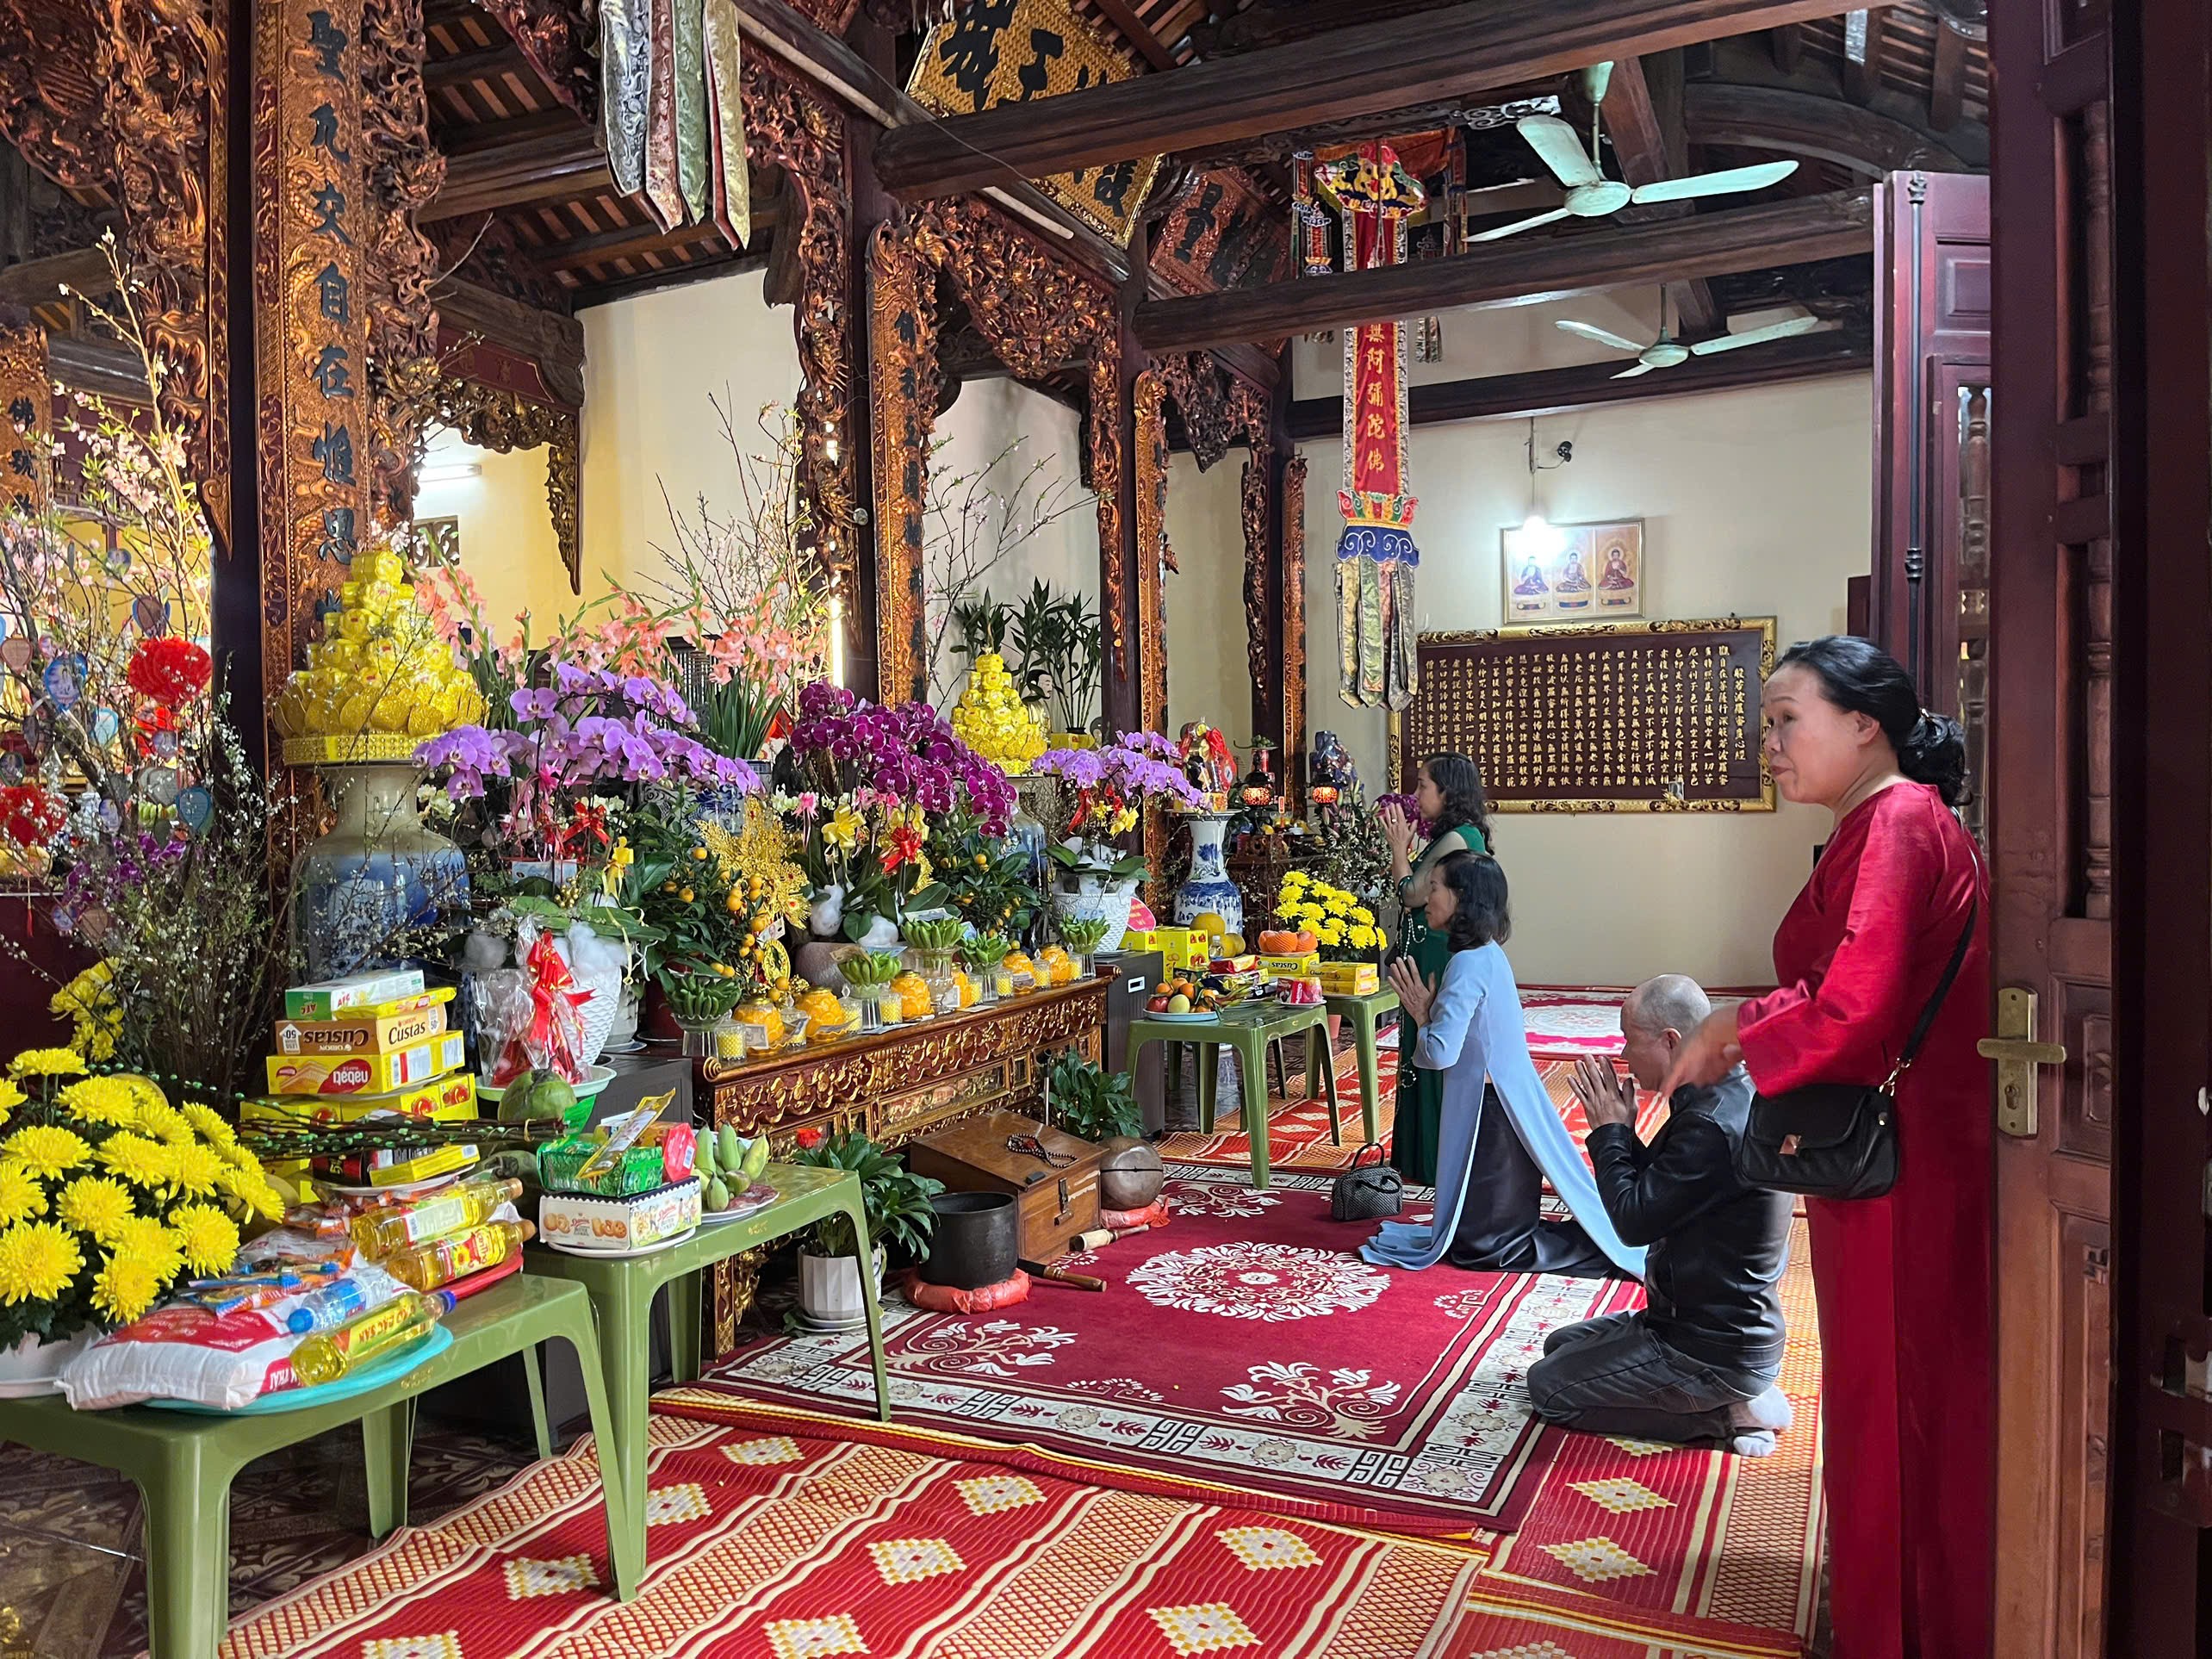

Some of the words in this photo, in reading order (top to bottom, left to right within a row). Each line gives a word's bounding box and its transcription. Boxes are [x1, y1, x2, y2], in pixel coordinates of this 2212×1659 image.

[1271, 960, 1298, 971] Custas
[303, 1027, 370, 1047] Custas
[388, 1022, 426, 1045] Custas
[332, 1071, 369, 1085] nabati
